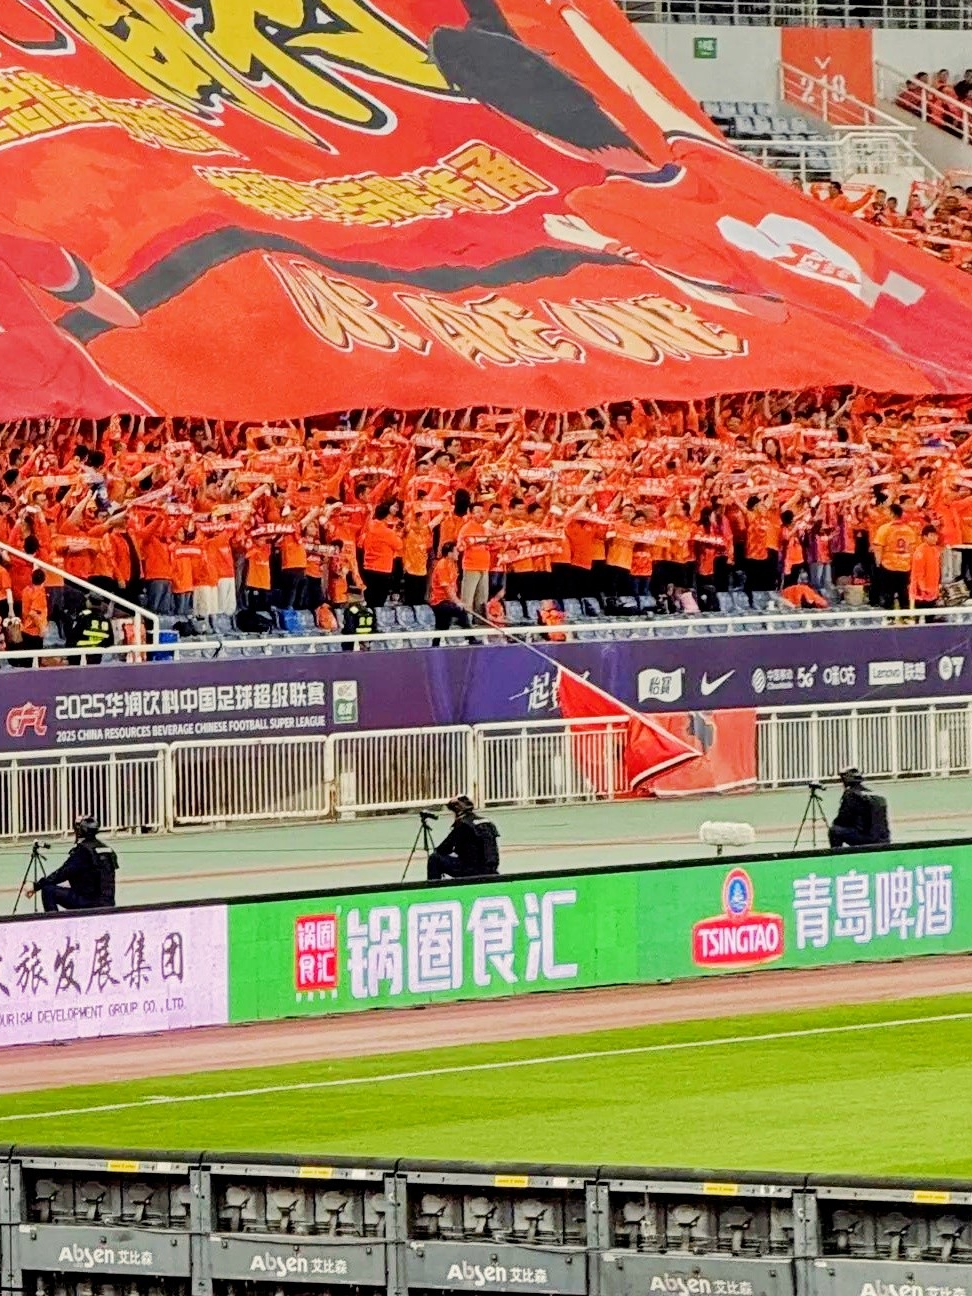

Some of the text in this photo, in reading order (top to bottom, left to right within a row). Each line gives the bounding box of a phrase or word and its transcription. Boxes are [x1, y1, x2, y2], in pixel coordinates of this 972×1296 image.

[55, 681, 325, 720] 2025华润饮料中国足球超级联赛
[56, 715, 326, 743] 2025 CHINA RESOURCES BEVERAGE CHINESE FOOTBALL SUPER LEAGUE
[346, 889, 578, 999] 锅圈食汇
[697, 921, 779, 958] TSINGTAO
[37, 1005, 103, 1024] DEVELOPMENT
[108, 1002, 138, 1017] GROUP
[117, 1250, 154, 1266] 艾比森
[310, 1258, 348, 1274] 艾比森
[509, 1267, 549, 1284] 艾比森
[713, 1279, 753, 1296] 艾比森
